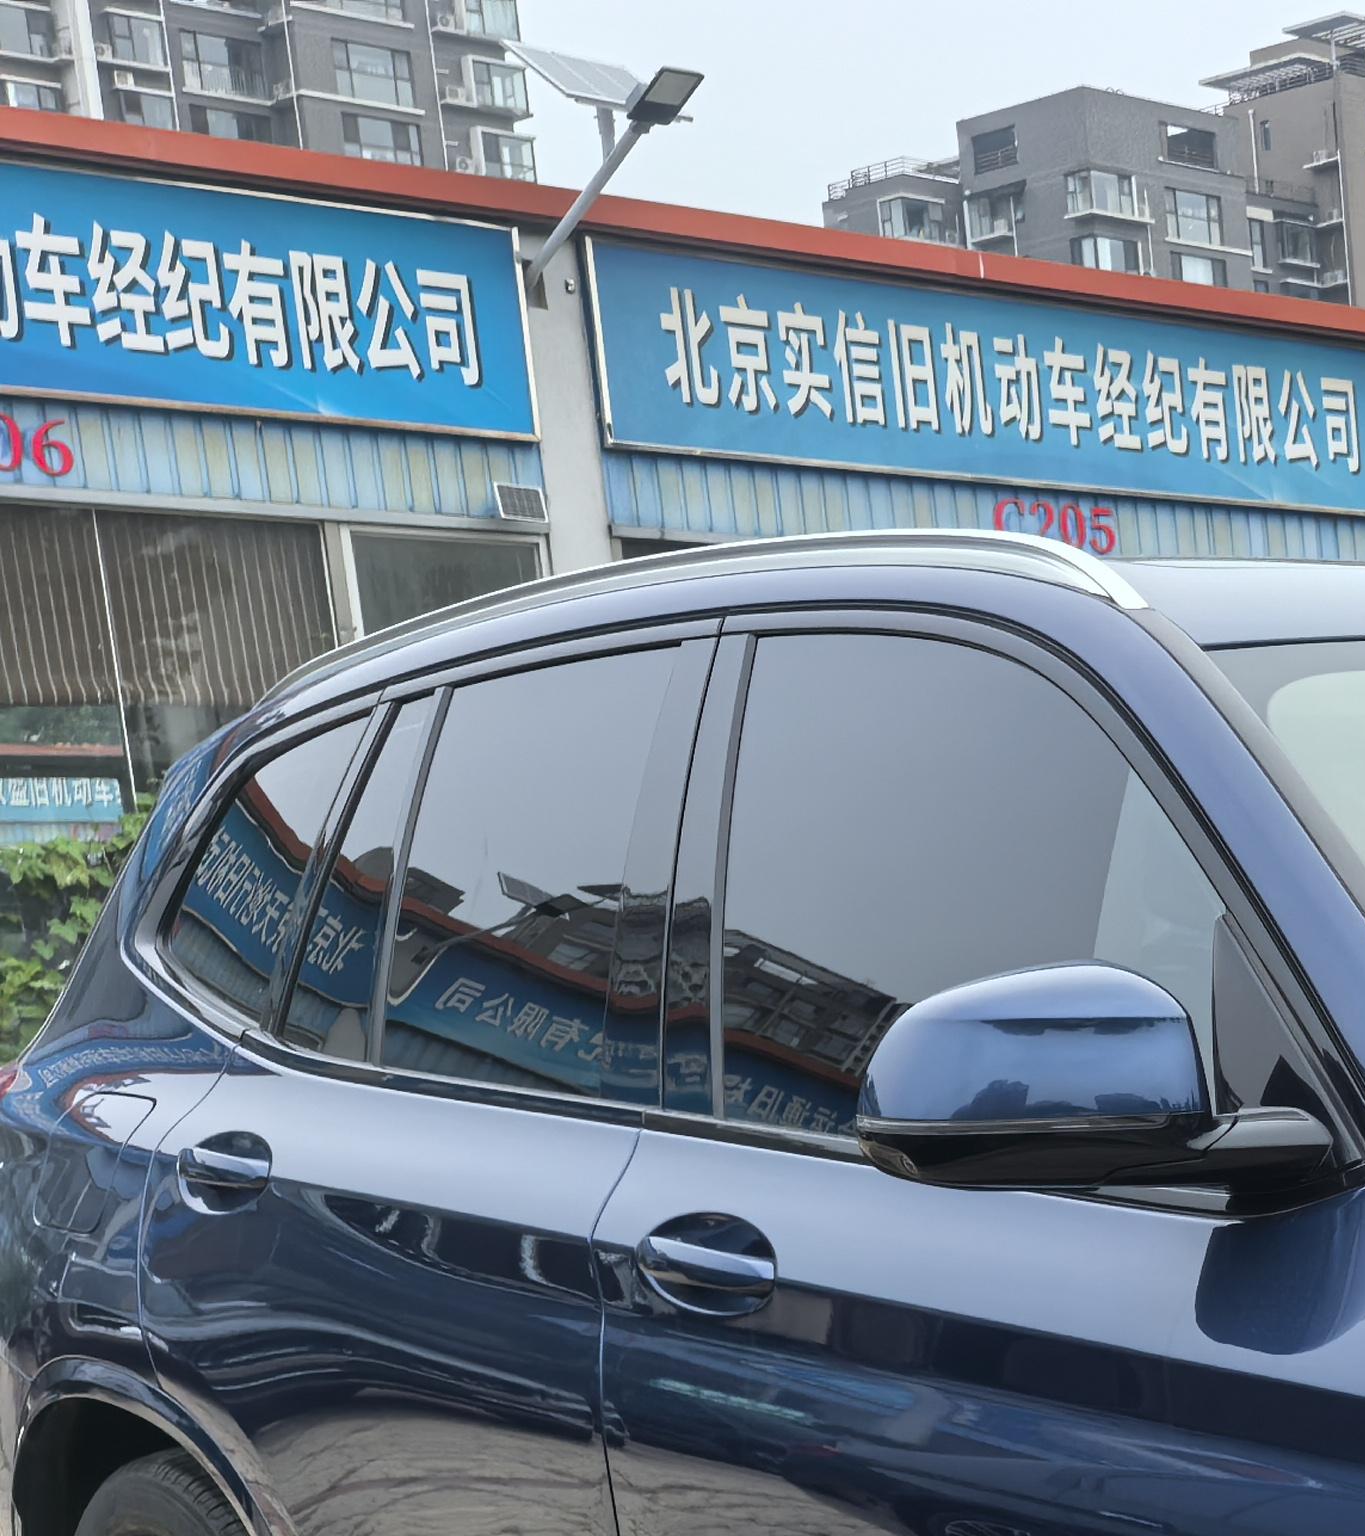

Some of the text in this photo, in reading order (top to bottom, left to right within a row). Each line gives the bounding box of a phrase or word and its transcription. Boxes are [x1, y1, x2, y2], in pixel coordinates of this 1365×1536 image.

[0, 212, 481, 386] 车经纪有限公司
[658, 285, 1362, 475] 北京实信旧机动车经纪有限公司
[993, 497, 1117, 556] C205
